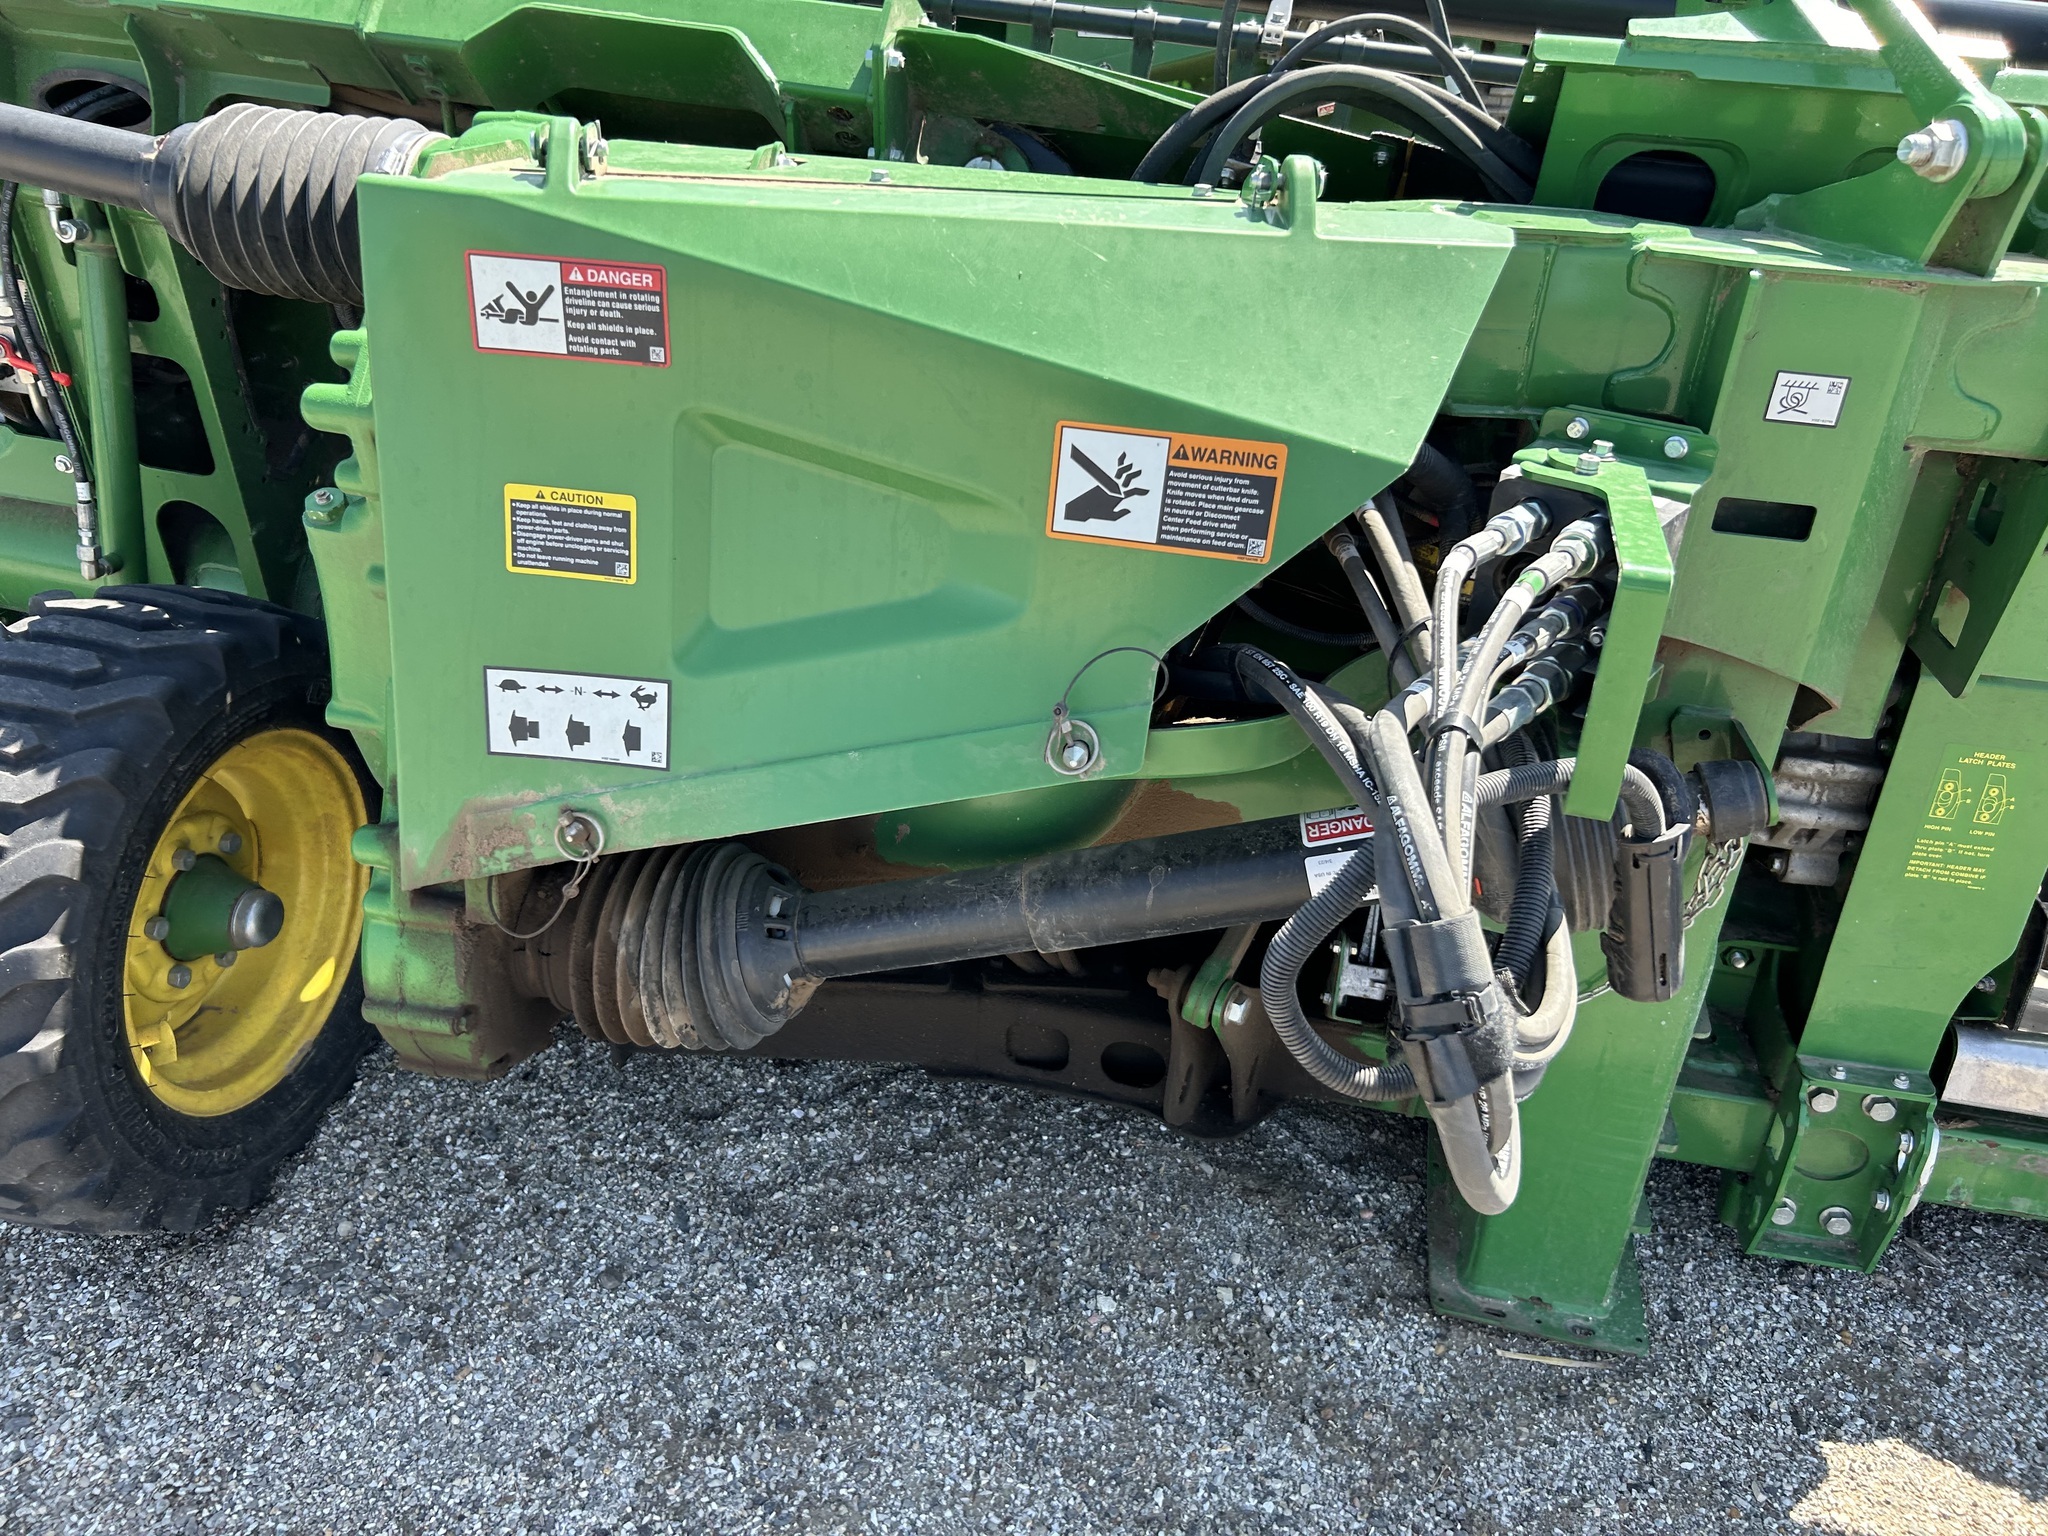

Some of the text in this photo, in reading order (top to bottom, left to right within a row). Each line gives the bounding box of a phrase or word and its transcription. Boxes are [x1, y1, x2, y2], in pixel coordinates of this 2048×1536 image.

[588, 269, 653, 287] DANGER
[564, 287, 617, 298] Entanglement
[630, 294, 660, 304] rotating
[565, 297, 596, 306] driveline
[634, 304, 660, 312] serious
[566, 306, 587, 316] injury
[600, 309, 623, 318] death.
[567, 320, 585, 330] Keep
[598, 324, 624, 332] shields
[634, 326, 656, 335] place.
[569, 334, 589, 343] Avoid
[591, 338, 618, 346] contact
[569, 345, 598, 355] rotating
[1191, 447, 1278, 470] WARNING
[1214, 476, 1233, 484] injury
[551, 491, 603, 505] CAUTION
[1204, 511, 1240, 521] Disconnect
[1161, 534, 1201, 543] maintenance
[1180, 528, 1215, 537] performing
[1272, 666, 1288, 680] 2SC
[1289, 682, 1305, 699] SAE
[1303, 697, 1316, 712] 100
[1325, 726, 1340, 741] DN
[1336, 740, 1346, 752] 16
[1343, 750, 1366, 778] MSHA
[1987, 761, 2016, 769] PLATES
[1308, 816, 1373, 837] DANGER
